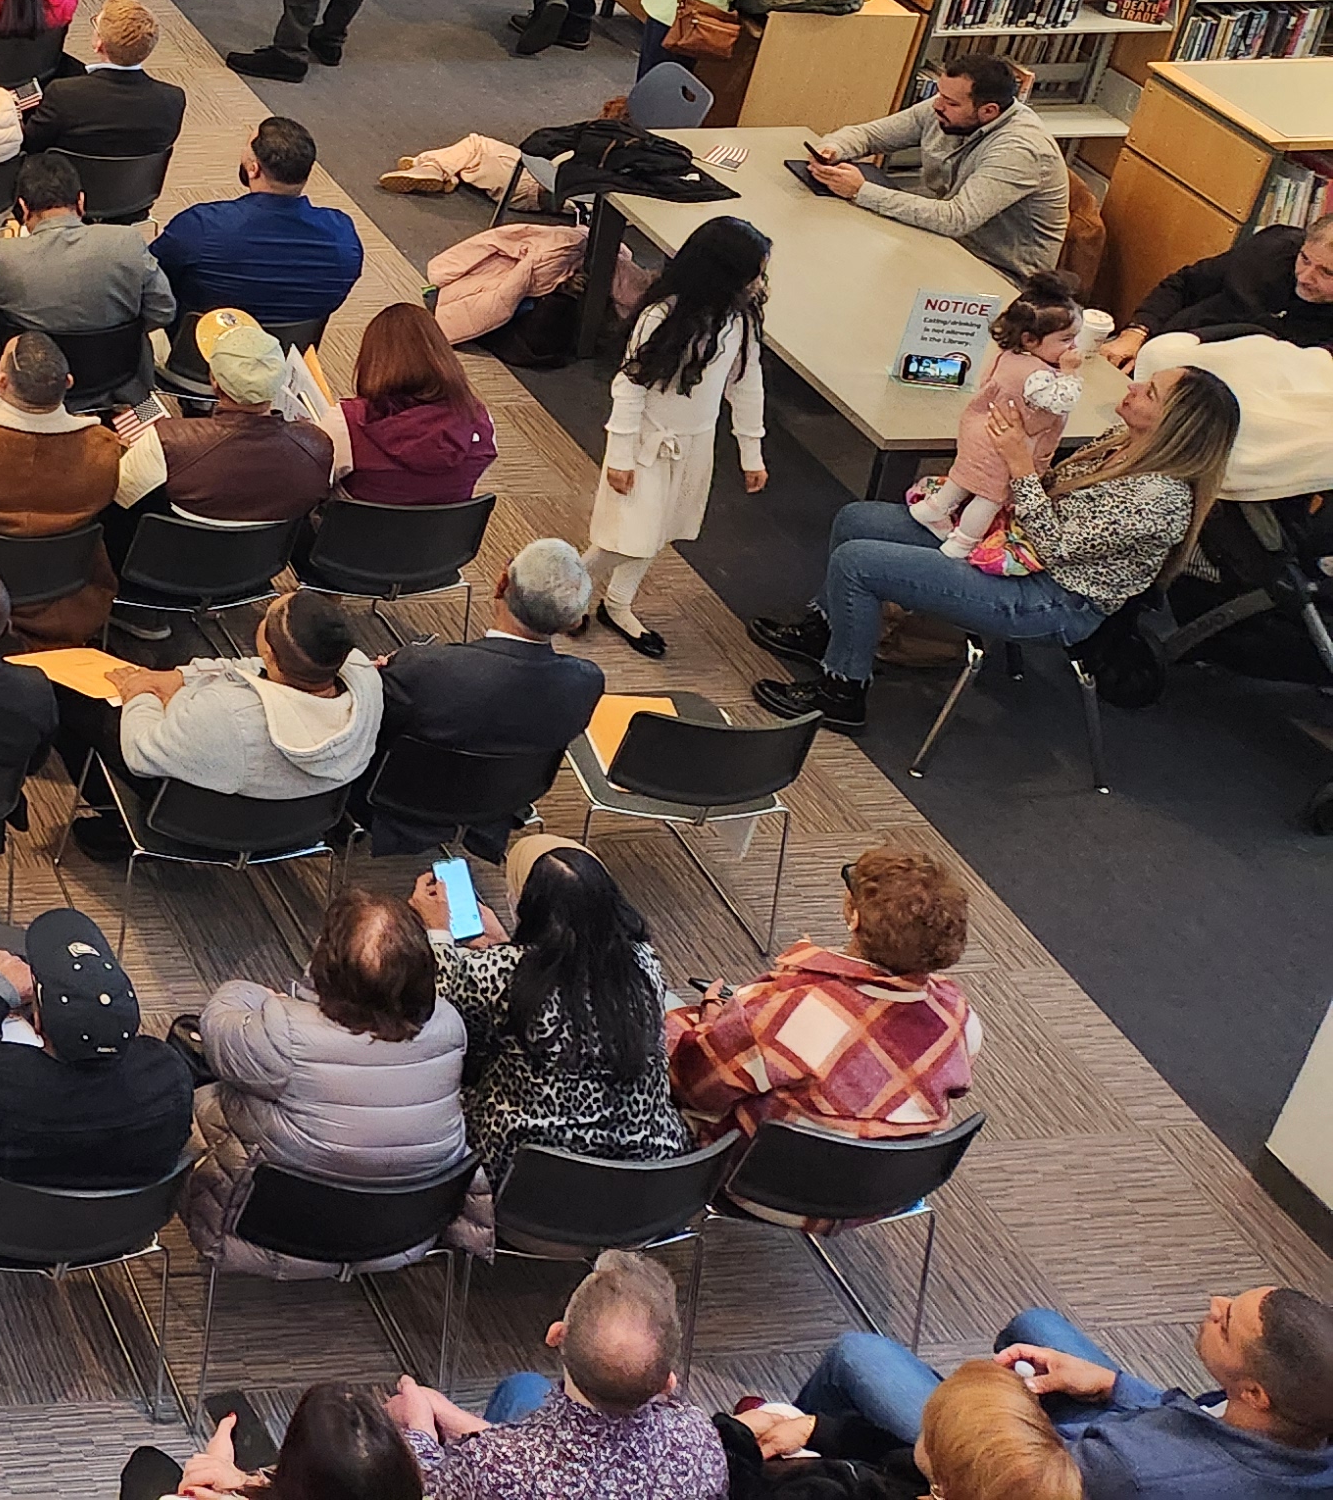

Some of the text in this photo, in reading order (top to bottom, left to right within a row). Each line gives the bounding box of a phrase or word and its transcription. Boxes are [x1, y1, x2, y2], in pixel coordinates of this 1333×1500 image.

[1122, 0, 1160, 13] DEATH
[1120, 9, 1157, 23] TRADE
[924, 298, 992, 317] NOTICE
[923, 317, 981, 330] Eating/drinking
[946, 329, 975, 338] allowed
